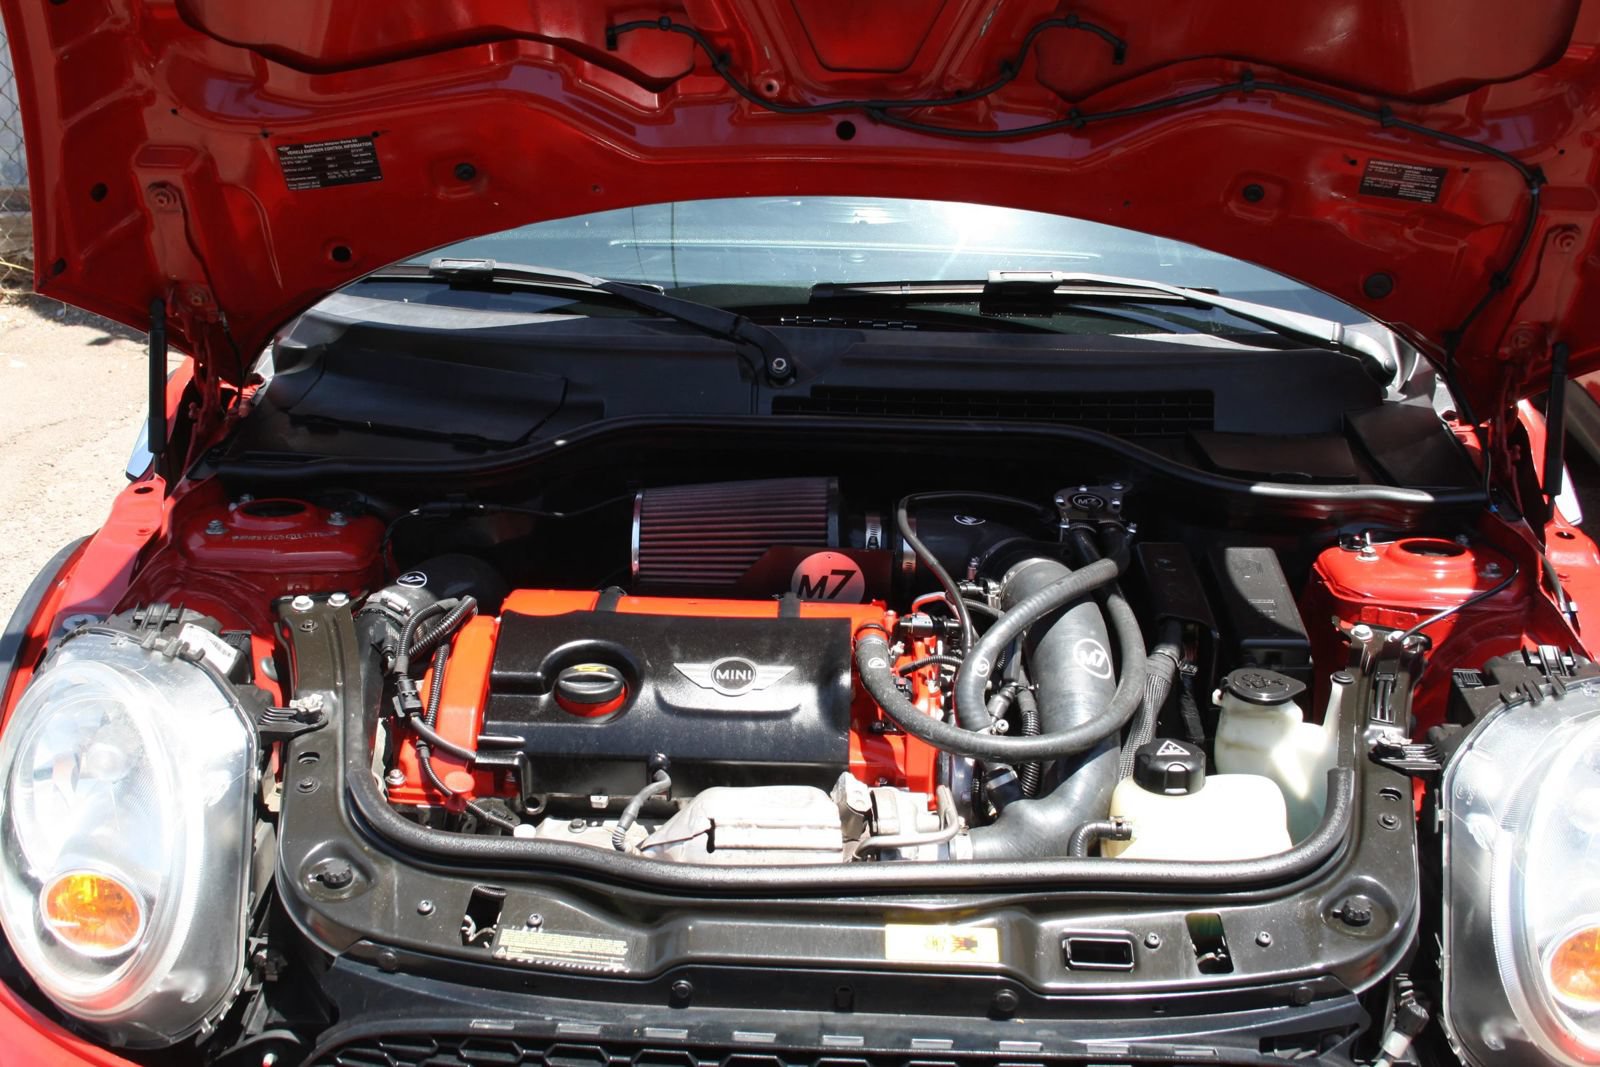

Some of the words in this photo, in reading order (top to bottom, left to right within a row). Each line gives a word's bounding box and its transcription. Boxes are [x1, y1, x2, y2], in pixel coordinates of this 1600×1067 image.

[344, 141, 373, 149] INFORMATION
[796, 569, 857, 600] M7
[1079, 648, 1106, 668] M7
[716, 669, 752, 681] MINI
